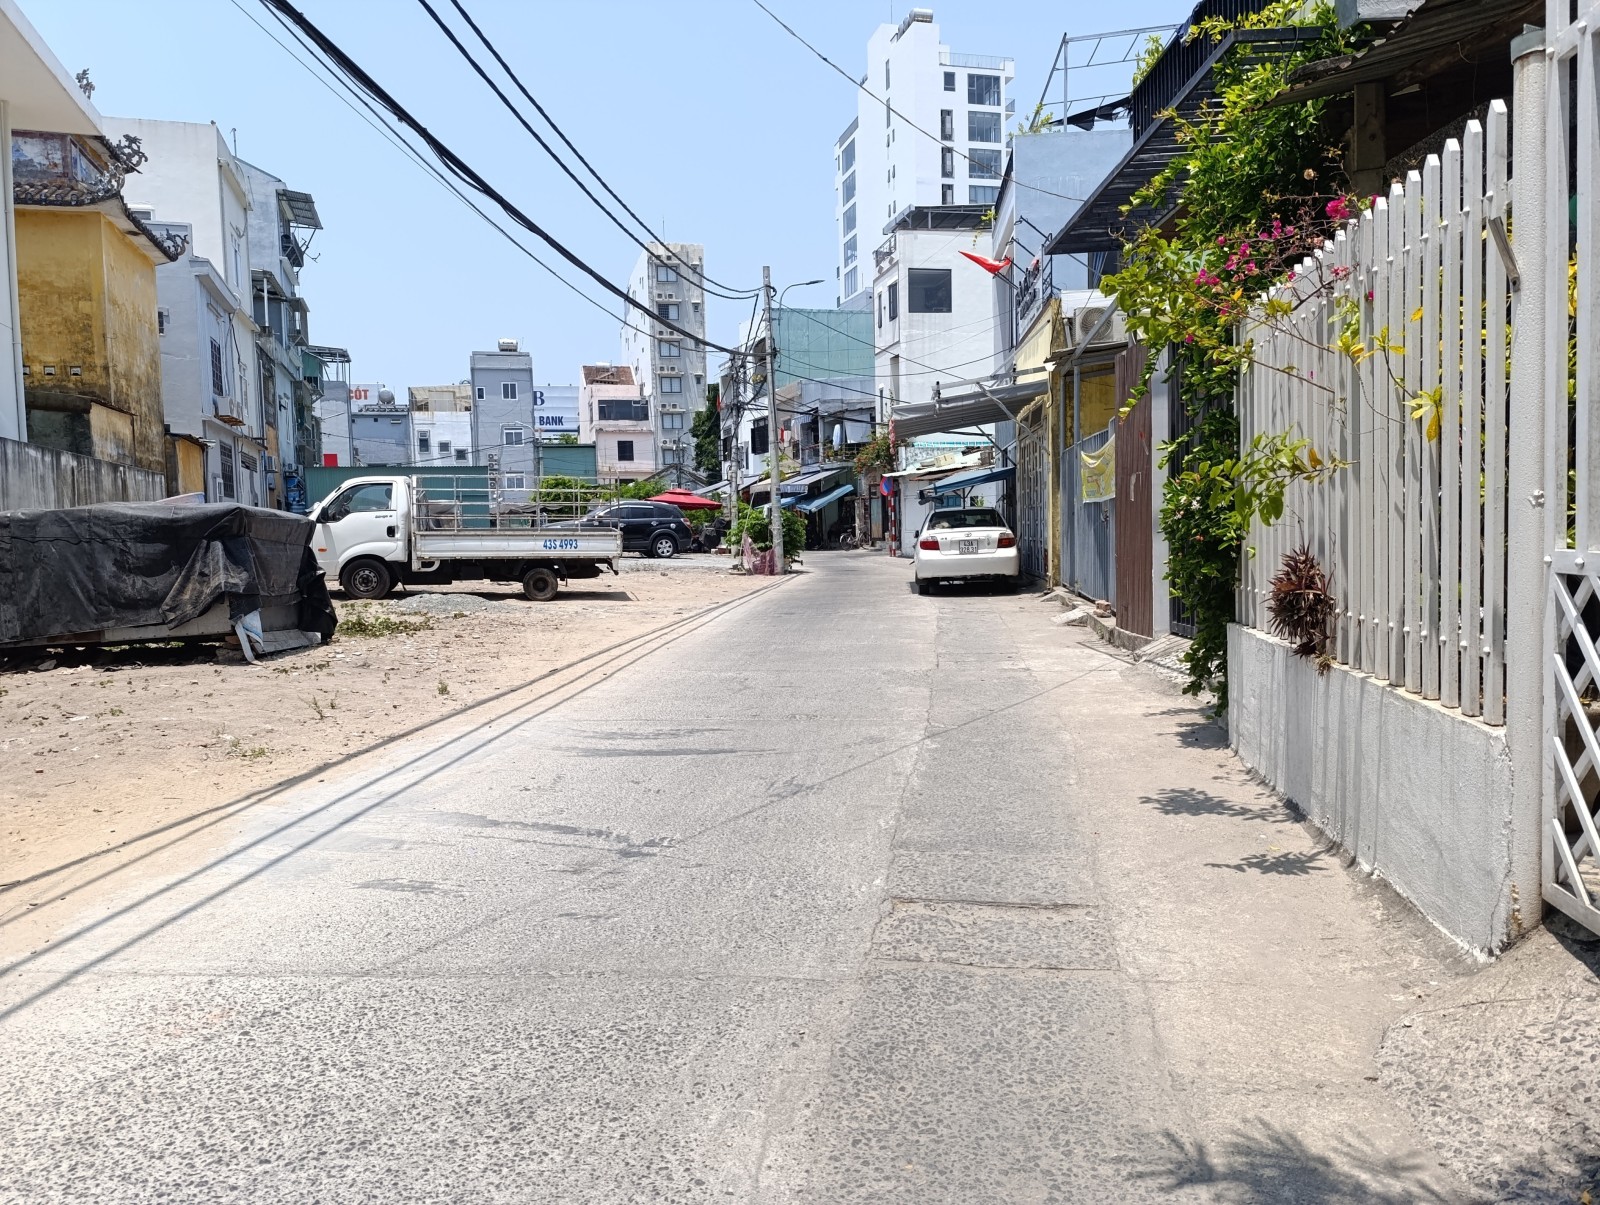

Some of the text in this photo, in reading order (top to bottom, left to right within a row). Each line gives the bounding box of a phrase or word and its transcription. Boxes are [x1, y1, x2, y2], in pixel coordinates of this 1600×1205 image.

[539, 415, 564, 426] BANK
[543, 539, 578, 549] 43S 4993
